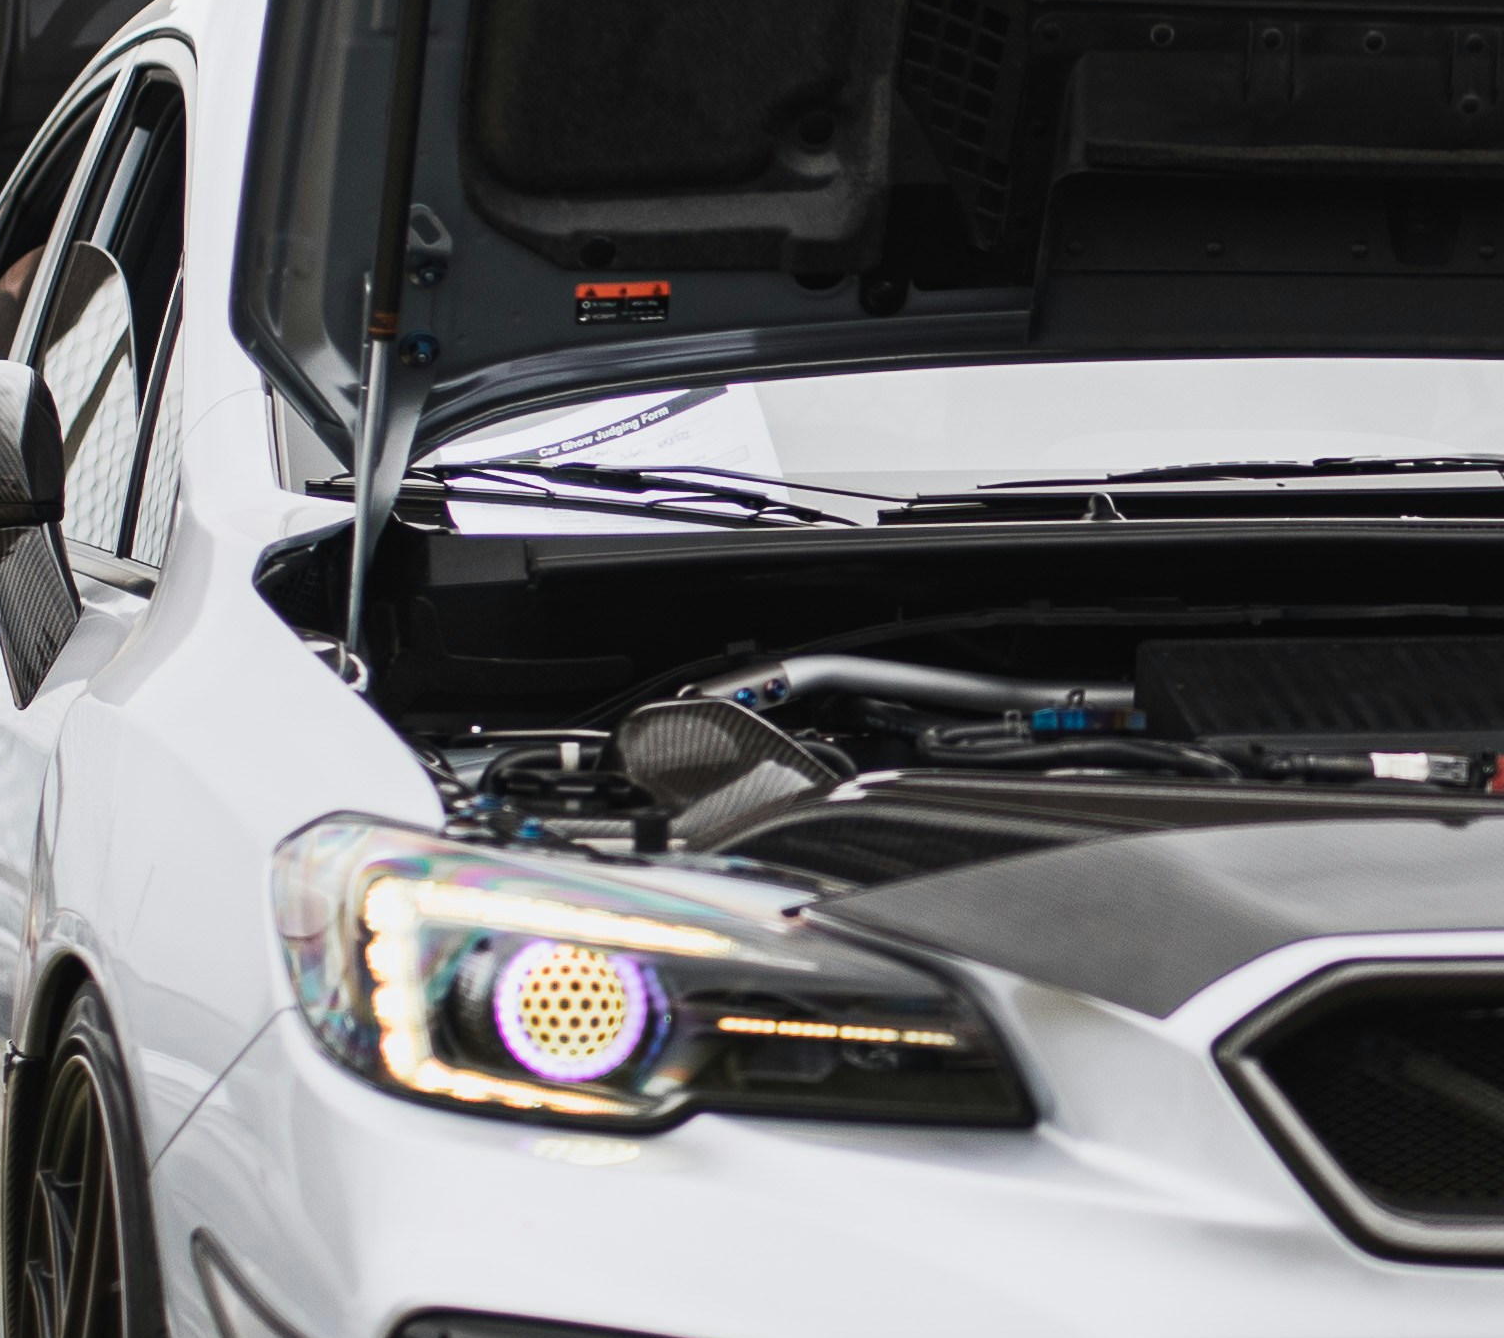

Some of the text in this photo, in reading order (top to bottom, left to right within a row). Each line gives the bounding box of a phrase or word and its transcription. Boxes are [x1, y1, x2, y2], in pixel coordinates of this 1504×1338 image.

[538, 445, 560, 457] Car
[561, 435, 594, 451] Show
[594, 419, 640, 441] Judging
[640, 406, 670, 424] Form
